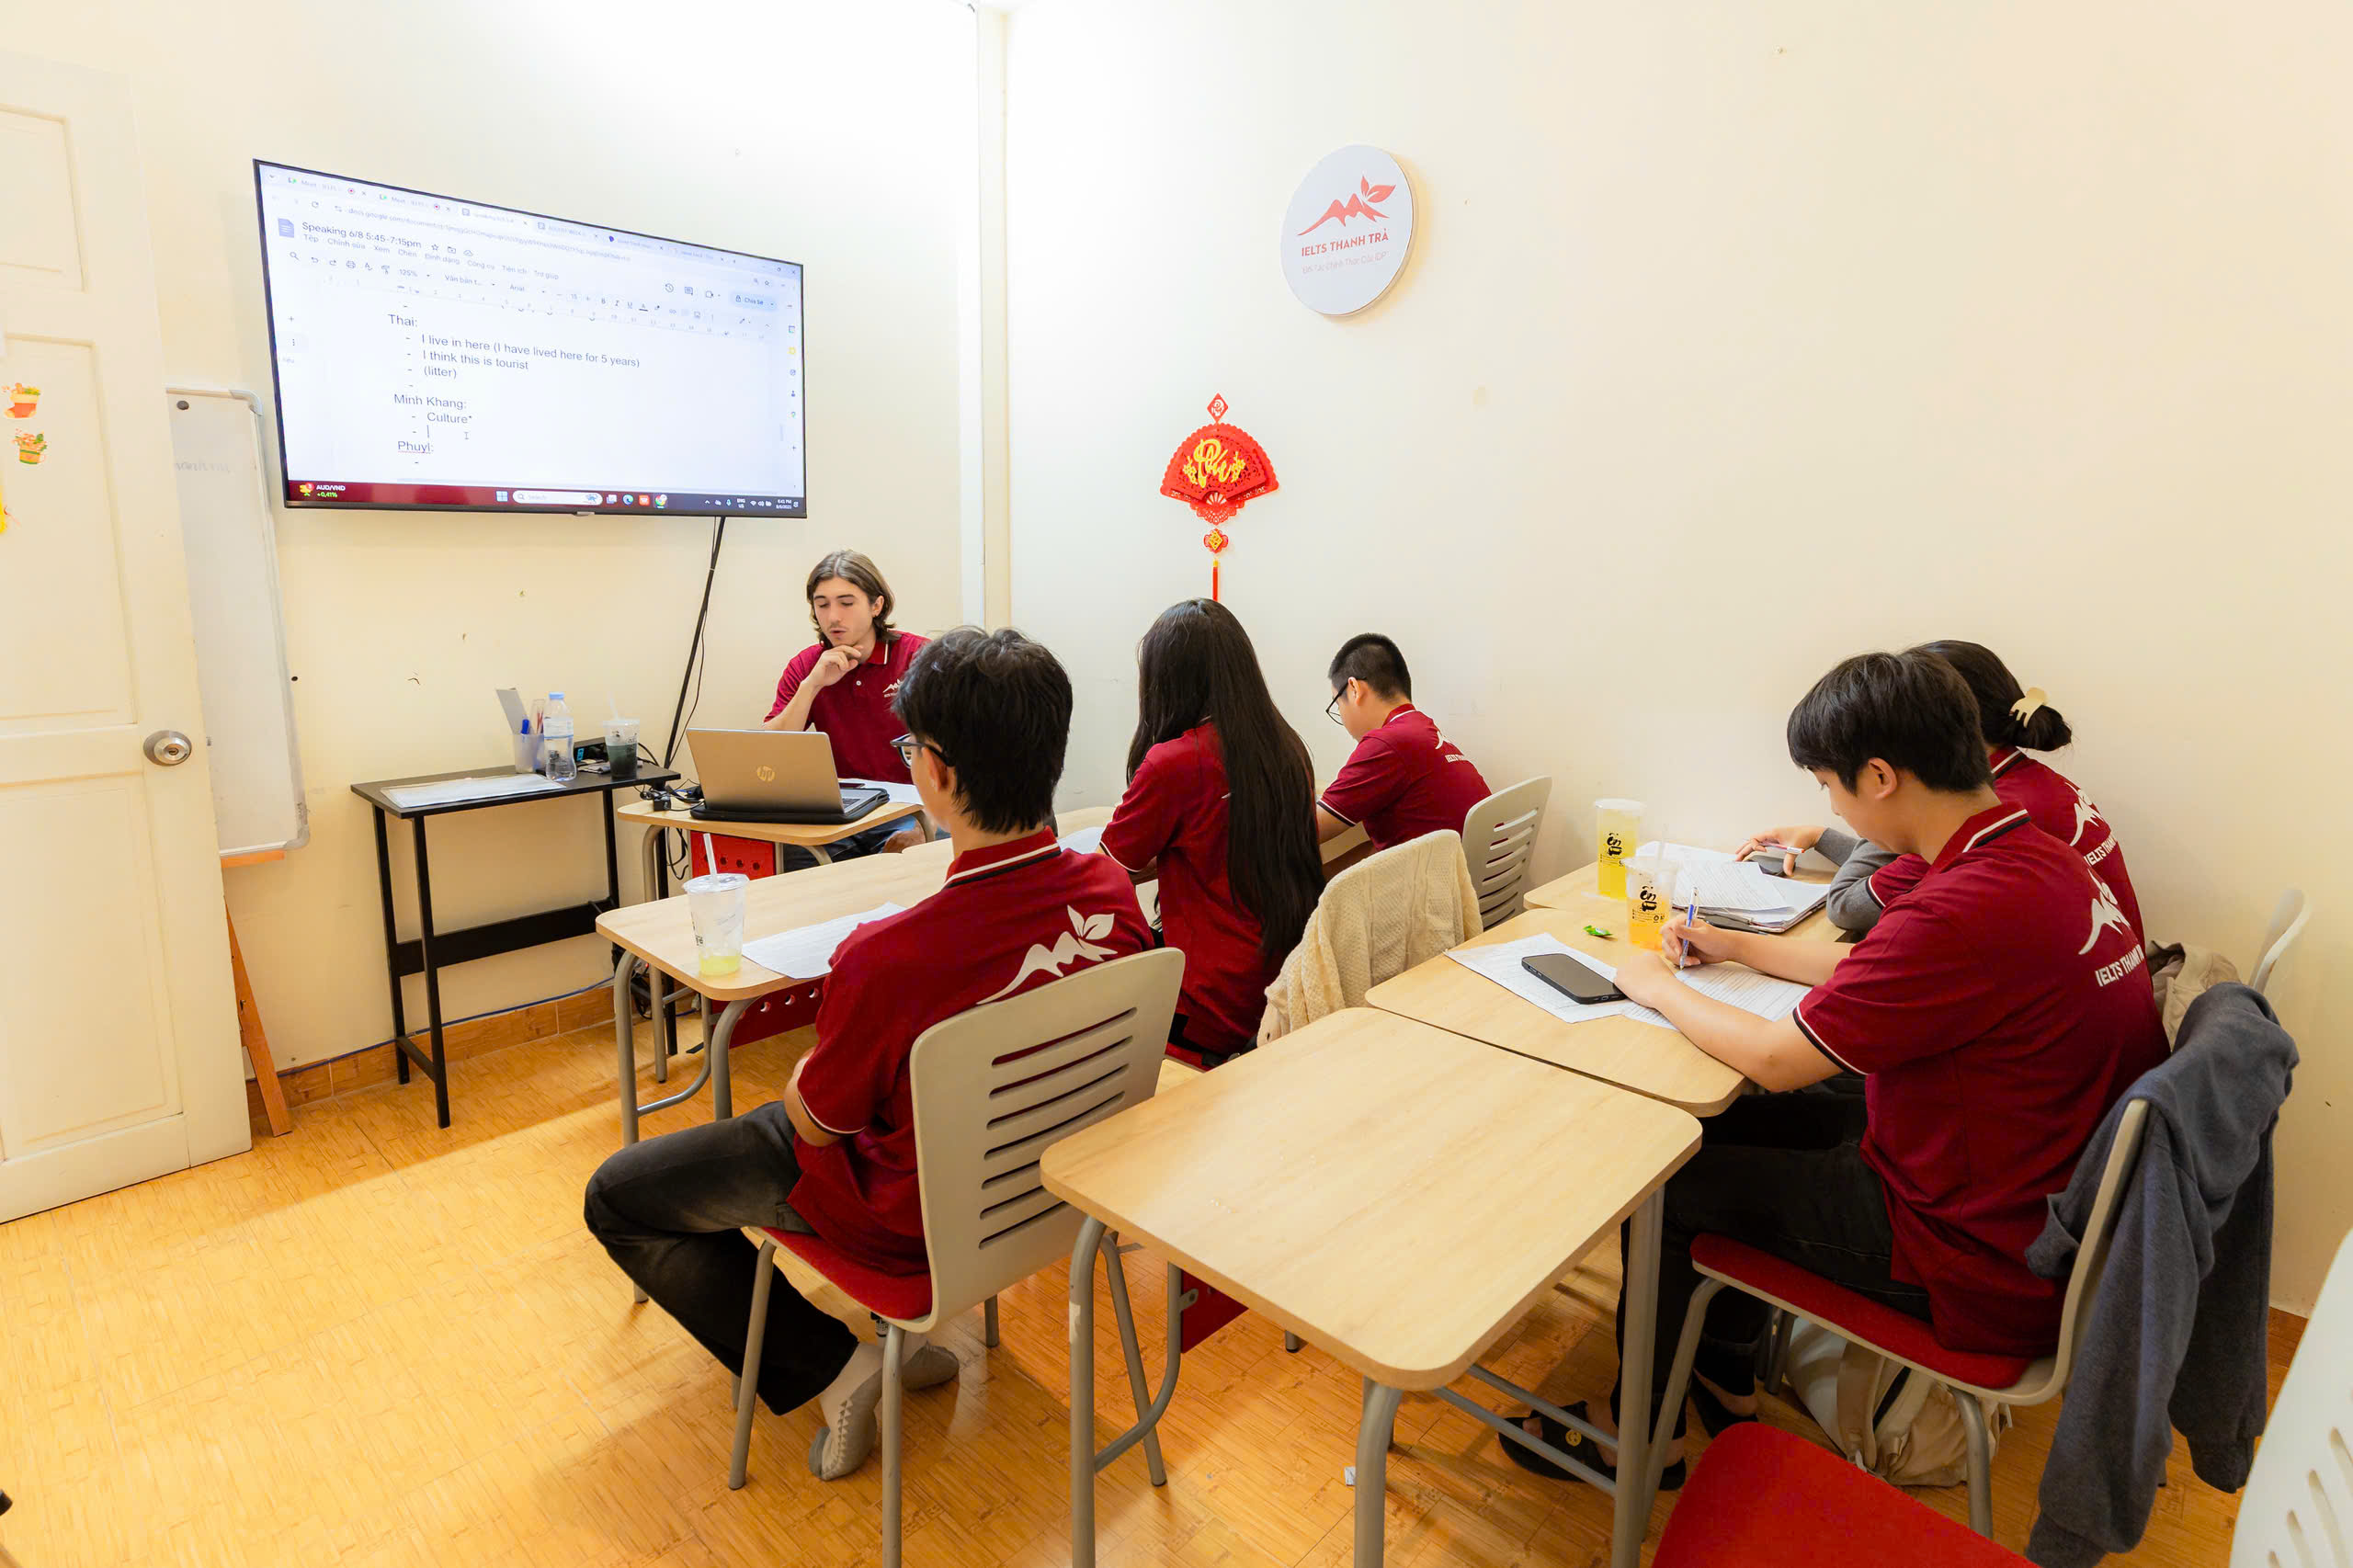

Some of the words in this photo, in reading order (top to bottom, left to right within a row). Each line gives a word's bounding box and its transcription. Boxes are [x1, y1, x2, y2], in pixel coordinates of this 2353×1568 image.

[301, 222, 347, 238] Speaking
[349, 230, 364, 239] 6/8
[1302, 244, 1327, 257] IELTS
[1330, 235, 1366, 252] THANH
[388, 313, 418, 327] Thai:
[429, 335, 449, 347] live
[451, 336, 461, 347] in
[465, 338, 490, 351] here
[493, 341, 501, 354] (I
[504, 344, 530, 356] have
[533, 347, 557, 358] lived
[560, 349, 583, 361] here
[585, 352, 598, 363] for
[601, 354, 608, 364] 5
[610, 357, 641, 369] years)
[430, 351, 458, 363] think
[460, 354, 480, 366] this
[483, 357, 493, 367] is
[495, 358, 529, 369] tourist
[424, 366, 458, 379] (litter)
[393, 393, 423, 406] Minh
[426, 396, 467, 411] Khang:
[316, 483, 346, 492] AUD/VND
[2083, 846, 2107, 867] IELTS
[2095, 961, 2123, 987] IELTS
